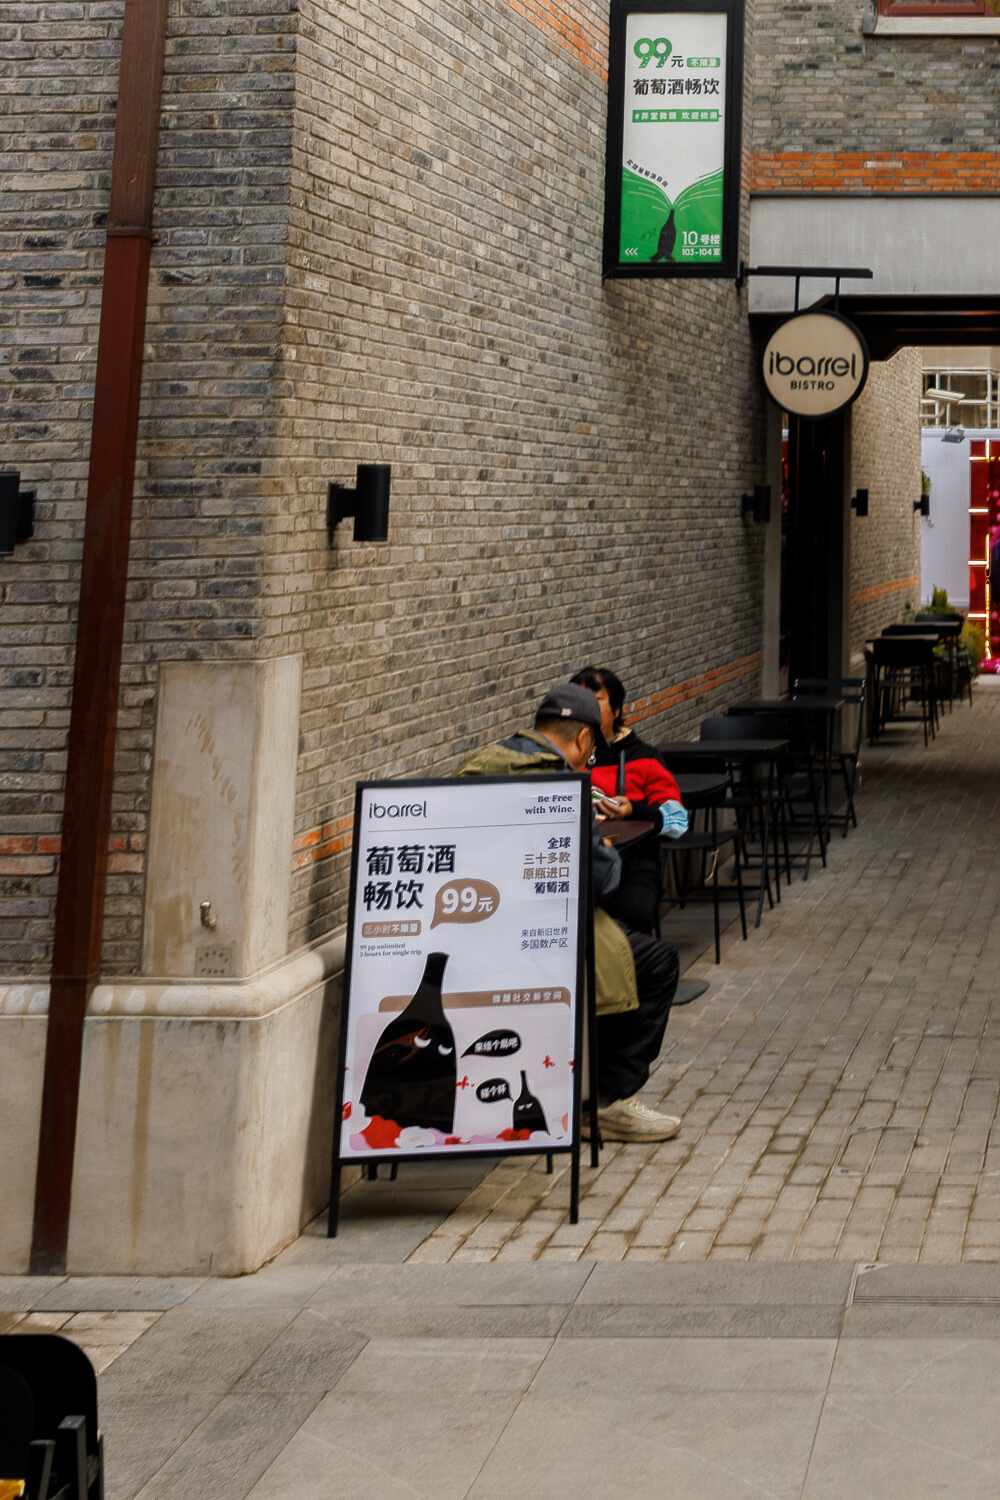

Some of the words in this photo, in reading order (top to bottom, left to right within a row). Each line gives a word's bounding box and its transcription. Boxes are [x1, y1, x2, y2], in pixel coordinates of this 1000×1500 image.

[632, 78, 720, 96] 葡萄酒畅饮
[682, 231, 698, 245] 10
[700, 234, 720, 245] 号楼
[769, 351, 856, 380] ibarrel
[790, 380, 835, 391] BISTRO
[537, 795, 549, 803] Be
[368, 800, 427, 819] ibarrel
[525, 806, 546, 815] with
[549, 805, 575, 814] Wine.
[547, 836, 571, 850] 全球
[366, 844, 457, 877] 葡萄酒
[523, 851, 571, 866] 三十多款
[522, 866, 570, 881] 原瓶进口
[534, 880, 570, 895] 葡萄酒
[362, 879, 425, 913] 畅饮
[364, 923, 418, 935] 三小时不限量
[520, 926, 569, 938] 来自新旧世界
[520, 937, 569, 951] 多国数产区
